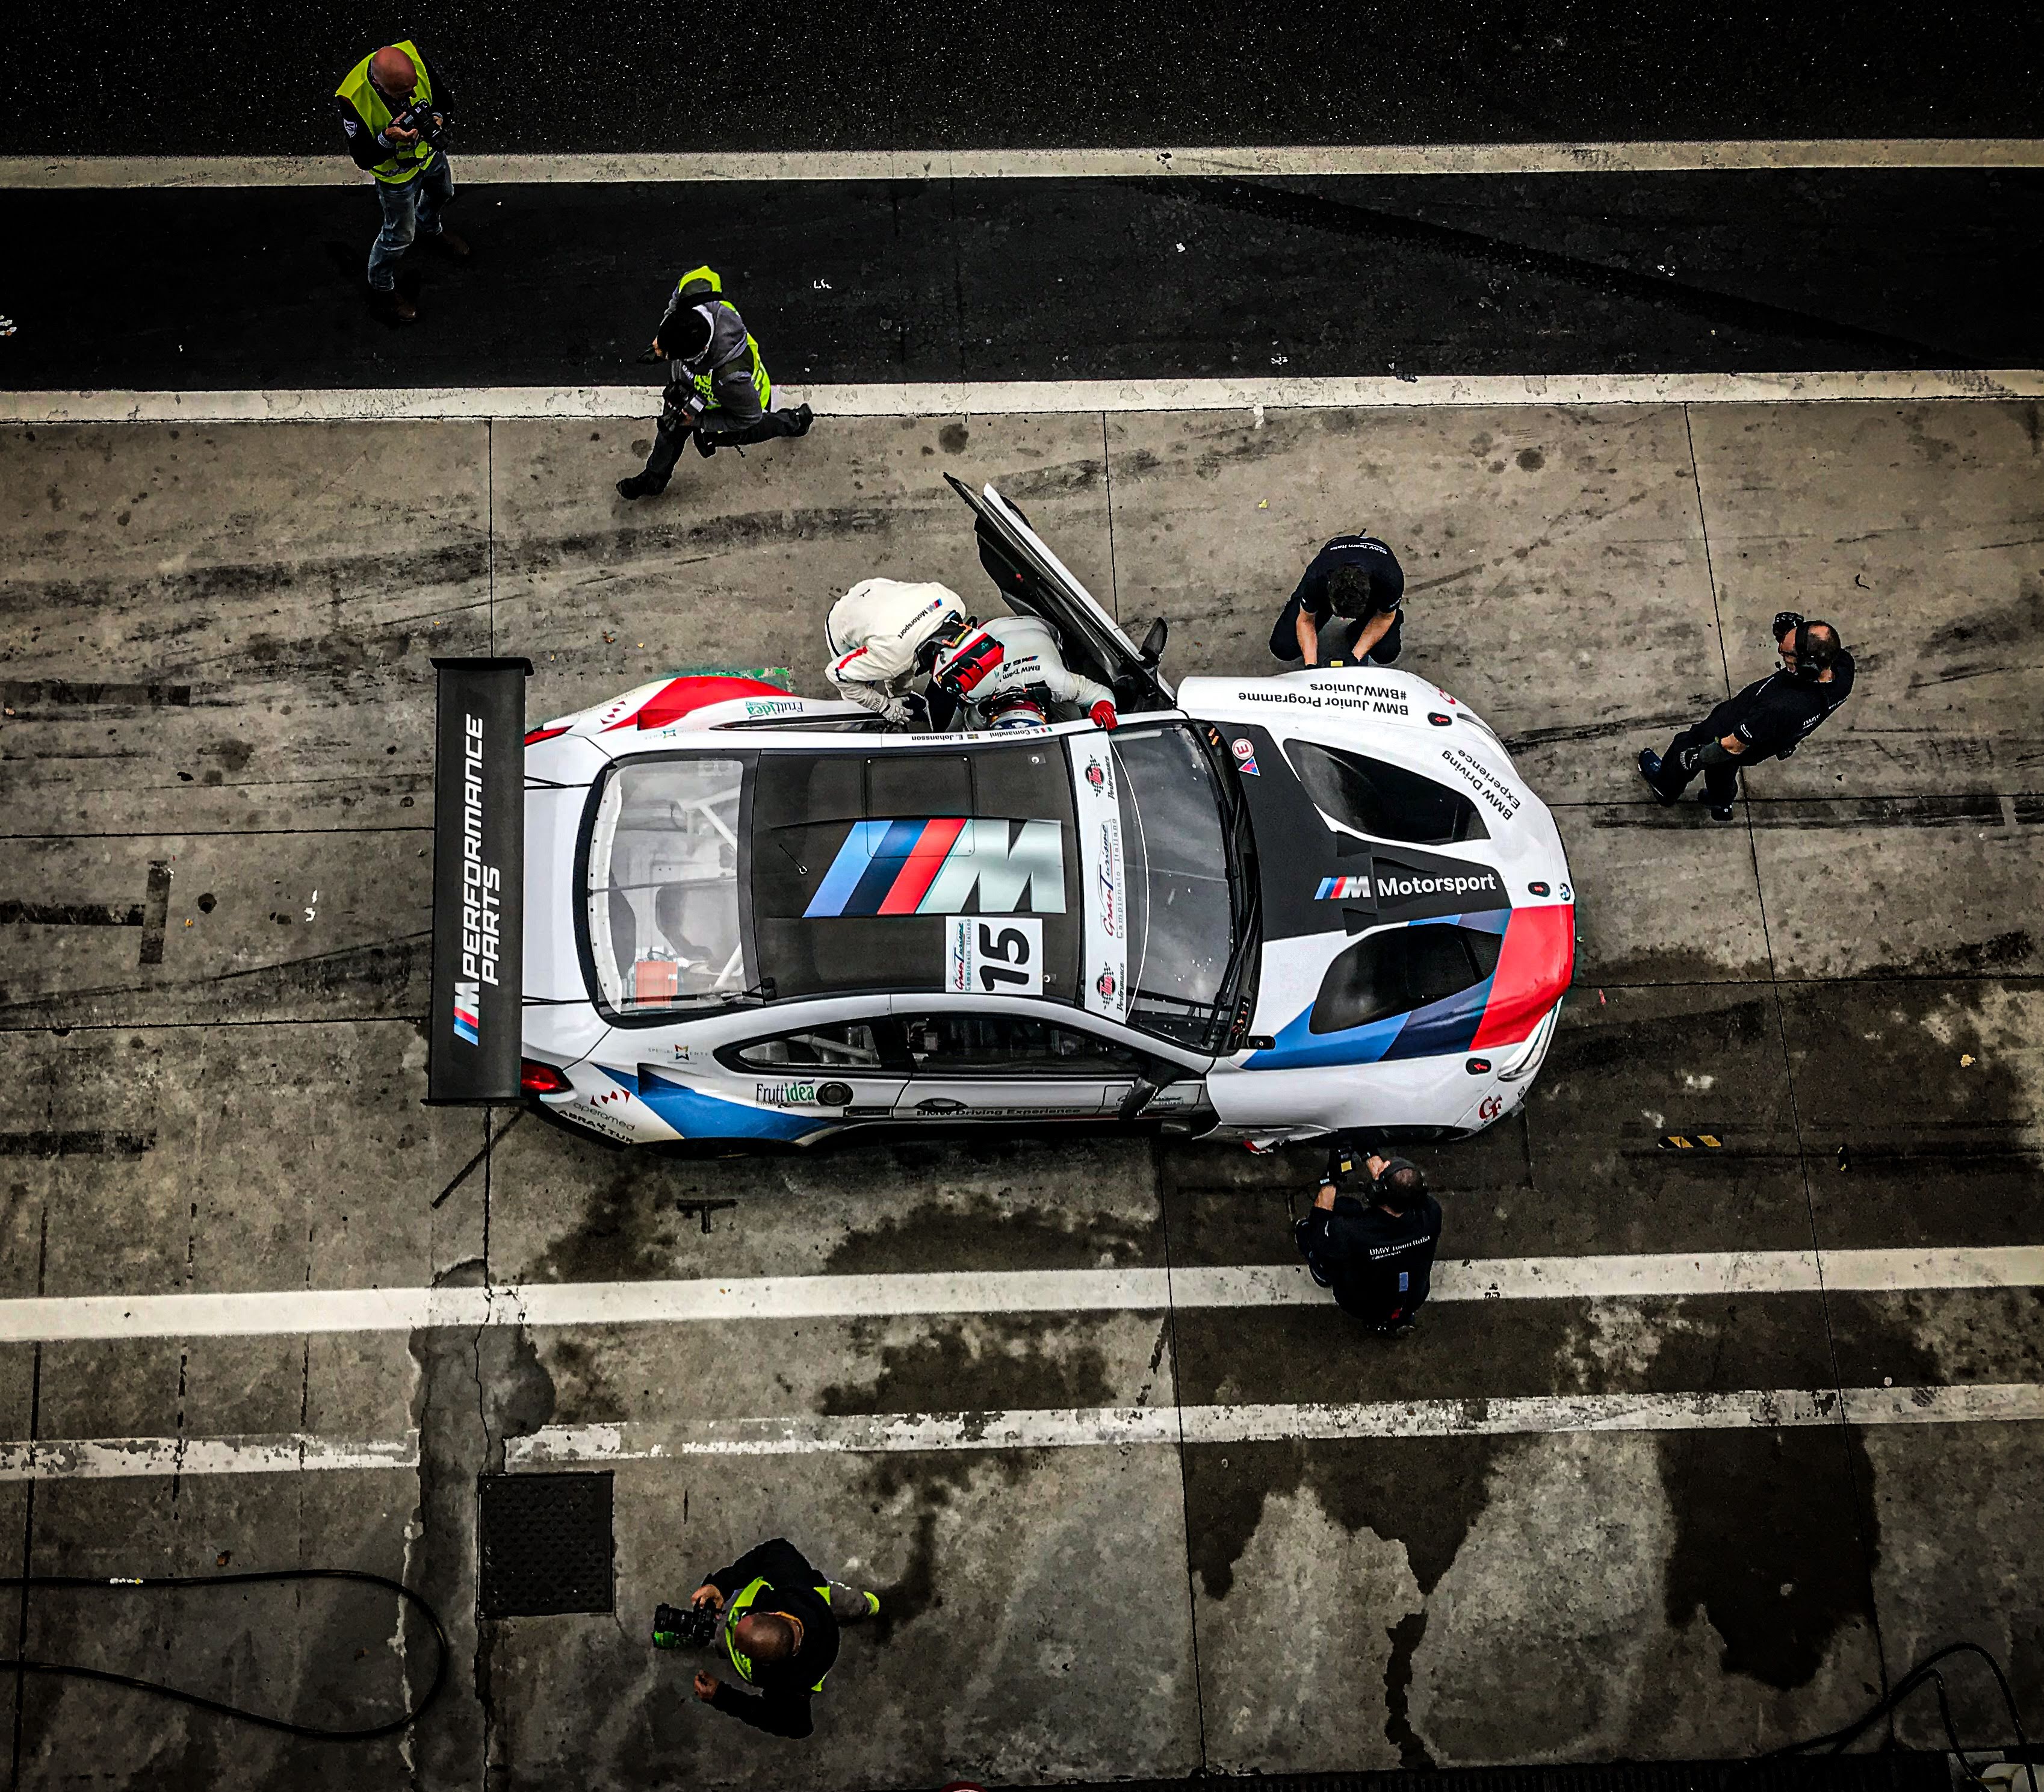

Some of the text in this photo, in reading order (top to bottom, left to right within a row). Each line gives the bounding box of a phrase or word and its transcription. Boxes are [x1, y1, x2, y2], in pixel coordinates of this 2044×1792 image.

[897, 609, 928, 639] Motorsport
[1021, 665, 1041, 674] BMW
[1238, 692, 1408, 716] BMW Junior Programme
[1310, 683, 1407, 701] #BMWJuniors
[747, 702, 804, 716] Fruttidea
[989, 728, 1030, 738] Comandini
[1236, 744, 1250, 754] E
[1105, 755, 1115, 800] Performance
[1442, 750, 1513, 820] BMW Driving
[1458, 749, 1520, 810] Experience
[463, 713, 483, 981] PERFORMANCE
[1112, 819, 1124, 939] Campionato Italiano
[1377, 873, 1496, 897] Motorsport
[482, 865, 500, 987] PARTS
[979, 923, 1030, 991] 15
[756, 1082, 815, 1102] Fruttidea
[573, 1102, 636, 1131] operamed
